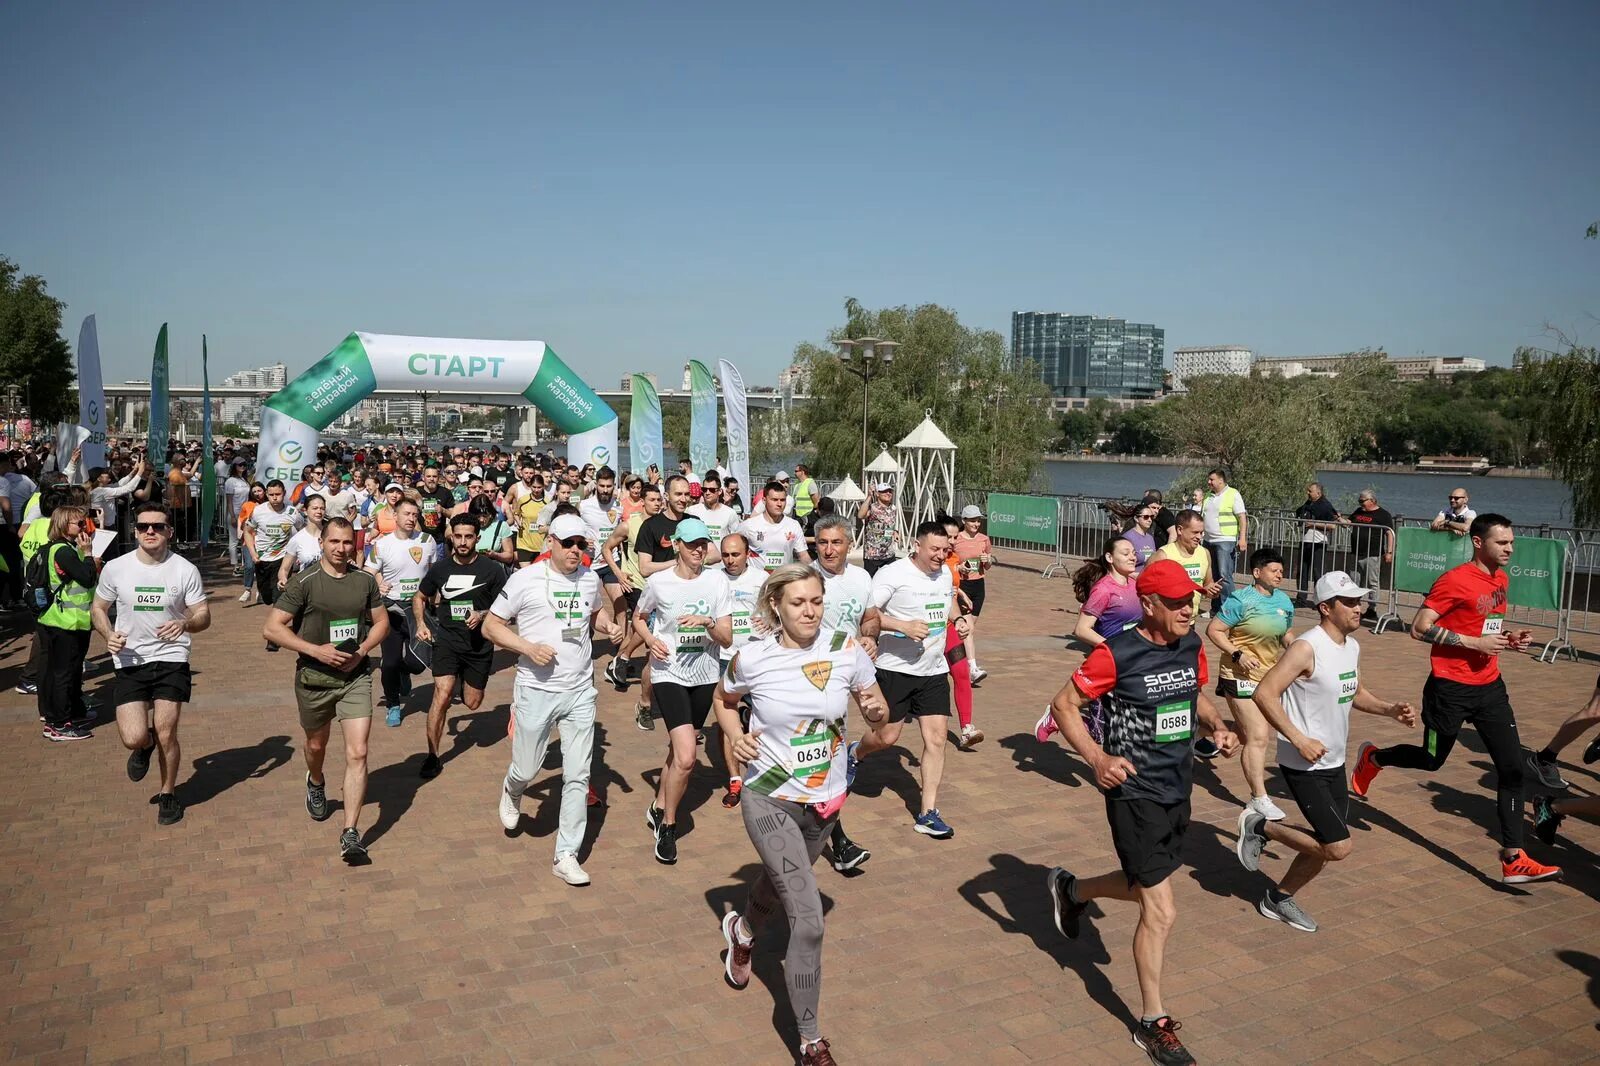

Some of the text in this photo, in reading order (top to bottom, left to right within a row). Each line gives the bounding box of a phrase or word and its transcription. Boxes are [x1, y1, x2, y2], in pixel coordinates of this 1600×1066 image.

[408, 353, 504, 378] СТАРТ
[305, 364, 352, 404] зелёный
[312, 375, 359, 413] марафон
[554, 375, 593, 412] зелёный
[546, 381, 586, 419] марафон
[84, 431, 106, 444] БЕР
[264, 467, 300, 481] СБЕ
[1409, 551, 1447, 562] зелёный
[1407, 560, 1446, 571] марафон
[1523, 568, 1549, 578] СБЕР
[137, 595, 161, 603] 0457
[928, 611, 944, 619] 1110
[733, 618, 748, 626] 206
[1486, 622, 1500, 631] 1424
[334, 627, 355, 638] 1190
[680, 635, 702, 644] 0110
[1143, 667, 1196, 687] SOCHI
[1342, 682, 1356, 693] 0644
[1161, 715, 1188, 729] 0588
[797, 746, 828, 762] 0636
